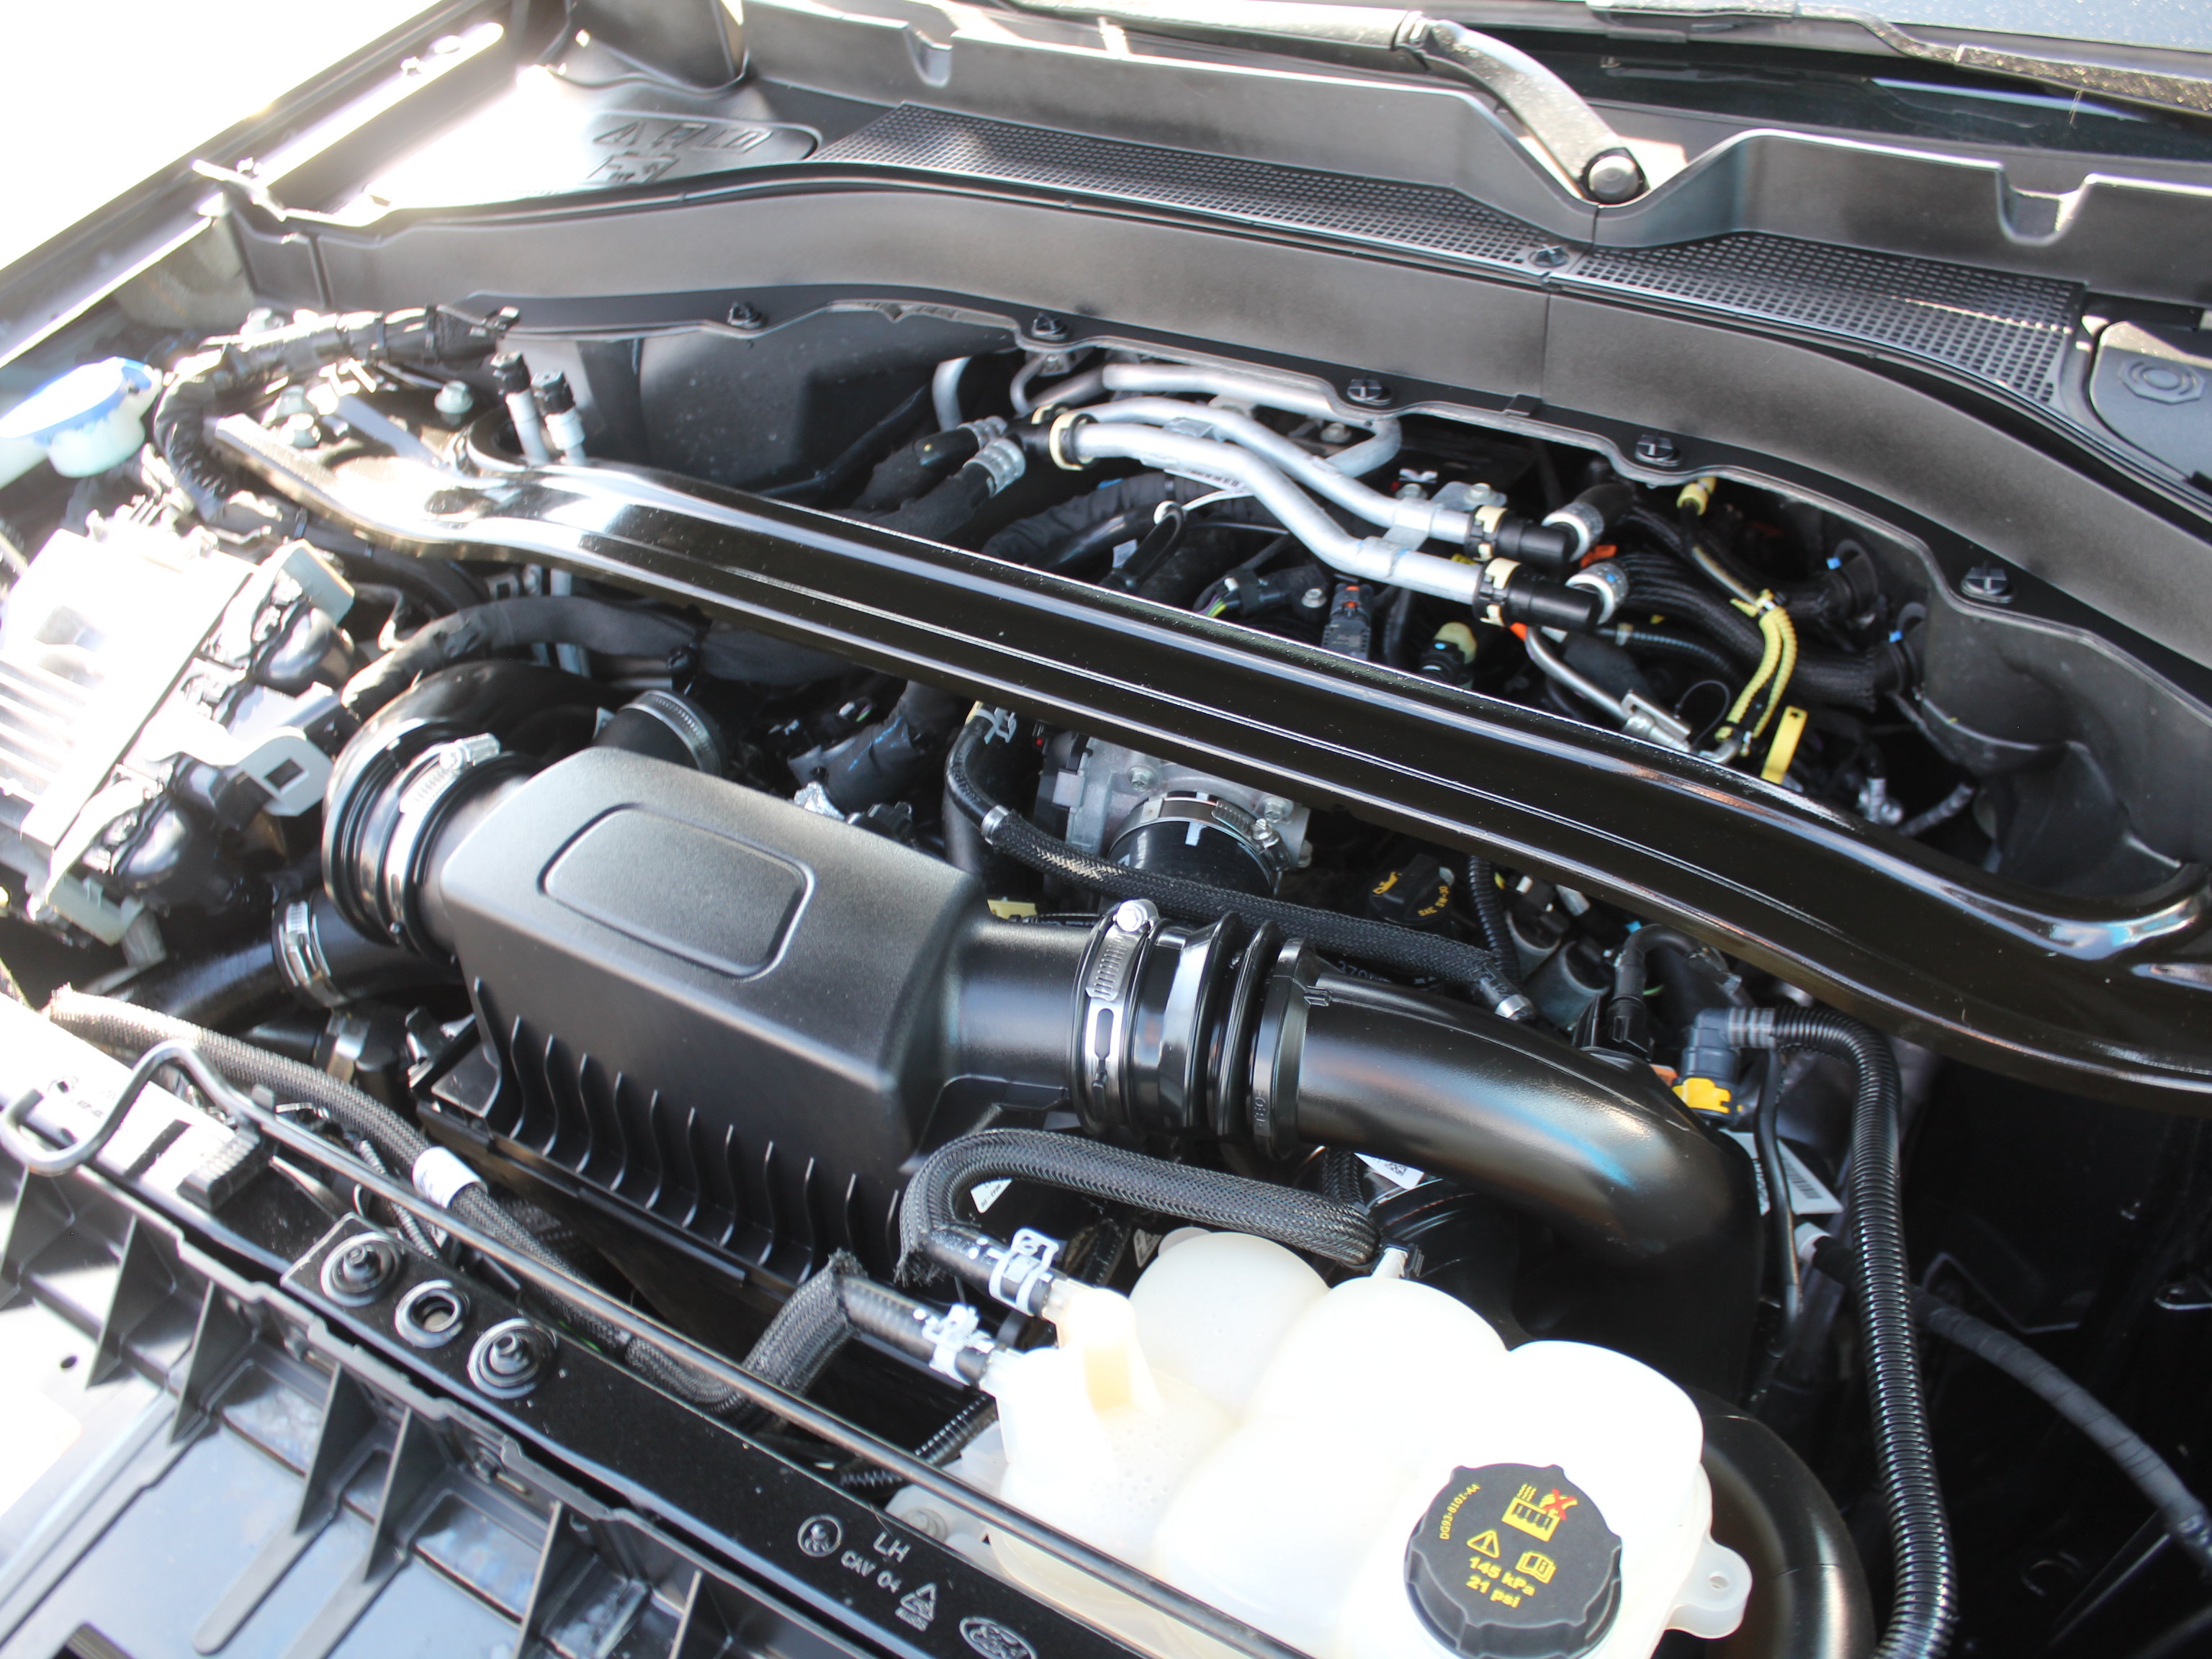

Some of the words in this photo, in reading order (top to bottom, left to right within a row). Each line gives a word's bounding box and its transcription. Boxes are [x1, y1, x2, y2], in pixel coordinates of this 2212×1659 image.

[1418, 907, 1437, 917] SAE
[873, 1532, 910, 1563] LH
[841, 1550, 876, 1577] CAV
[877, 1570, 901, 1593] 04
[1469, 1556, 1502, 1578] 145
[1501, 1571, 1536, 1596] kPa
[1466, 1575, 1491, 1593] 21
[1490, 1588, 1521, 1608] psi
